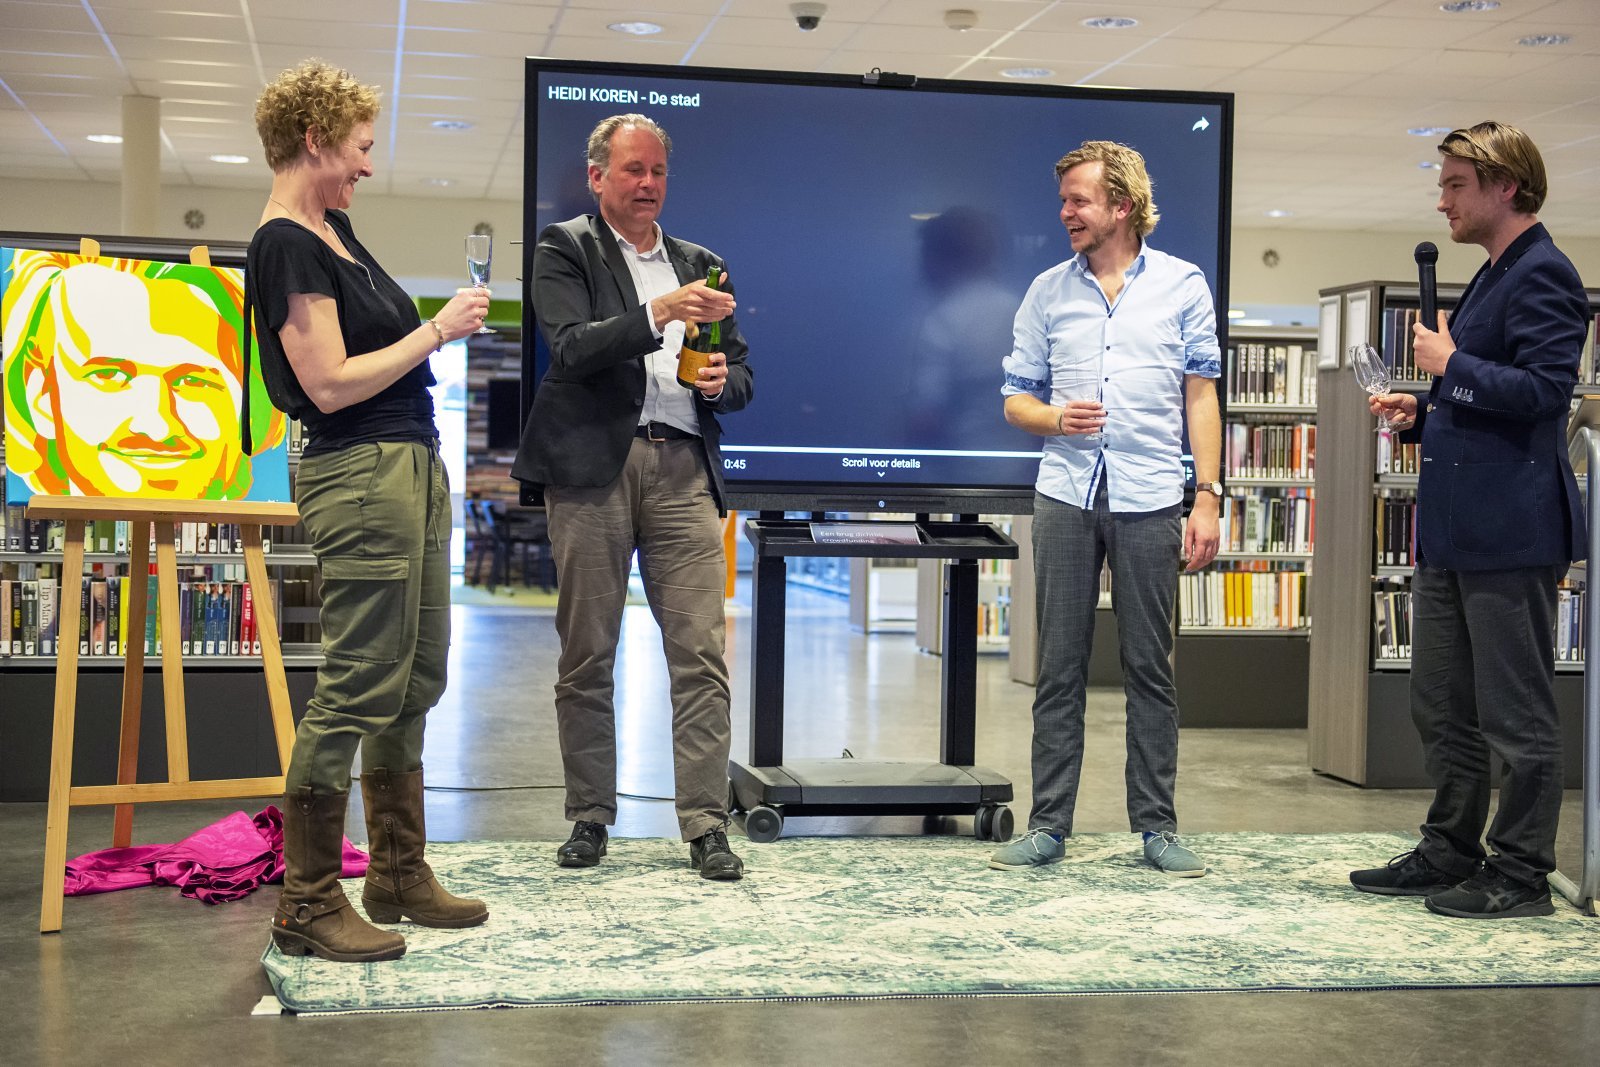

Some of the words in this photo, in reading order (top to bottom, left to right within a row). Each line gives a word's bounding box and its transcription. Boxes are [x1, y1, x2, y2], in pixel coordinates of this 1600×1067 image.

[548, 85, 586, 101] HEIDI
[590, 88, 638, 104] KOREN
[649, 91, 667, 105] De
[670, 93, 700, 107] stad
[724, 458, 746, 469] 0:45
[842, 457, 868, 468] Scroll
[869, 459, 889, 468] voor
[891, 458, 921, 469] details
[40, 585, 52, 601] Tip
